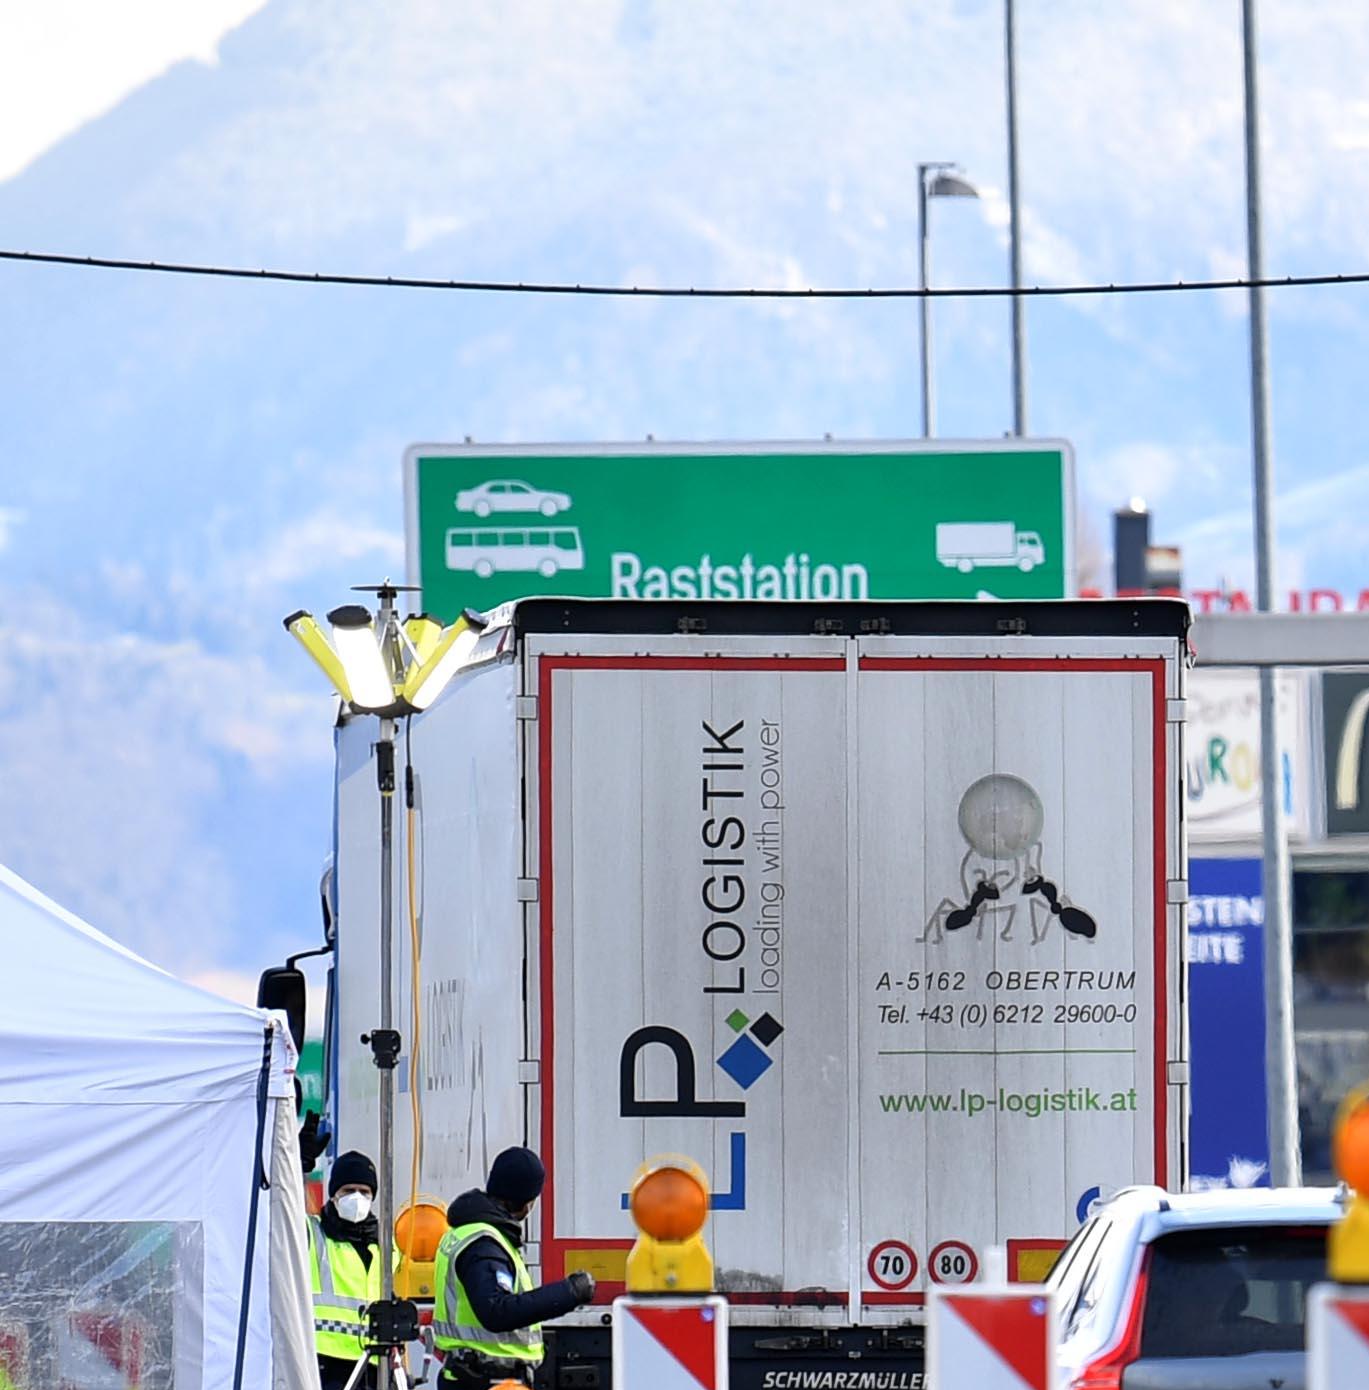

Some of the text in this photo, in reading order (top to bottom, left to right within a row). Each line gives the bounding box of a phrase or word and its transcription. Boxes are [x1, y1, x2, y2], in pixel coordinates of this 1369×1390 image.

[611, 552, 868, 599] Raststation
[702, 720, 745, 993] LOGISTIK
[752, 718, 785, 994] loading with power
[875, 970, 1137, 991] A-5162 OBERTRUM
[878, 1003, 1138, 1028] Tel. +43 (0) 6212 29600-0
[879, 1087, 1138, 1118] www.lp-logistik.at
[880, 1255, 905, 1275] 70
[940, 1255, 966, 1275] 80
